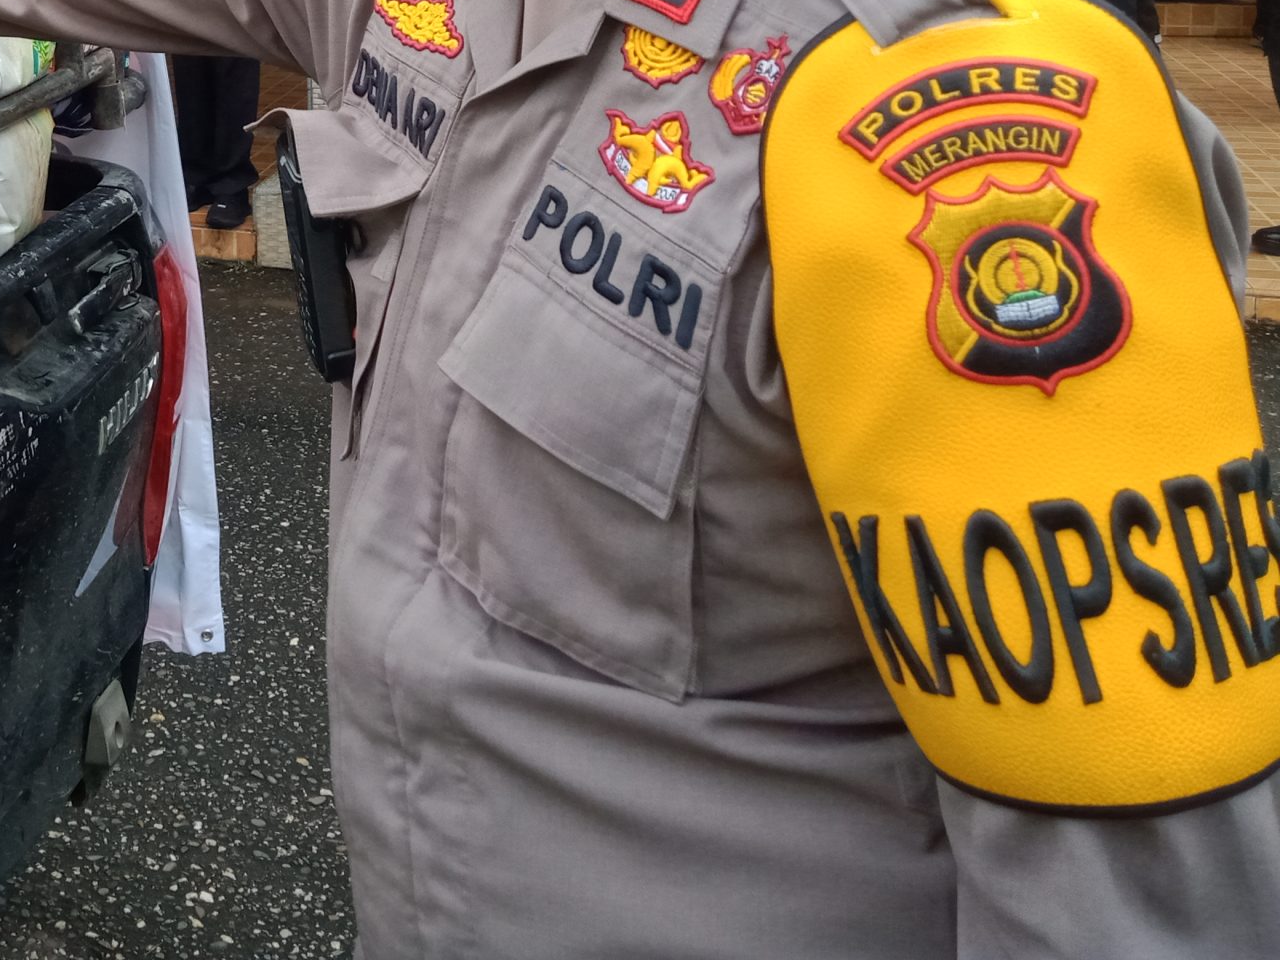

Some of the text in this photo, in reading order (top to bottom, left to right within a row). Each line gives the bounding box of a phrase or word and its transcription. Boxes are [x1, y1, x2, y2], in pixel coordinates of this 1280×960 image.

[861, 65, 1082, 144] POLRES
[901, 124, 1062, 184] MERANGIN
[522, 183, 704, 350] POLRI
